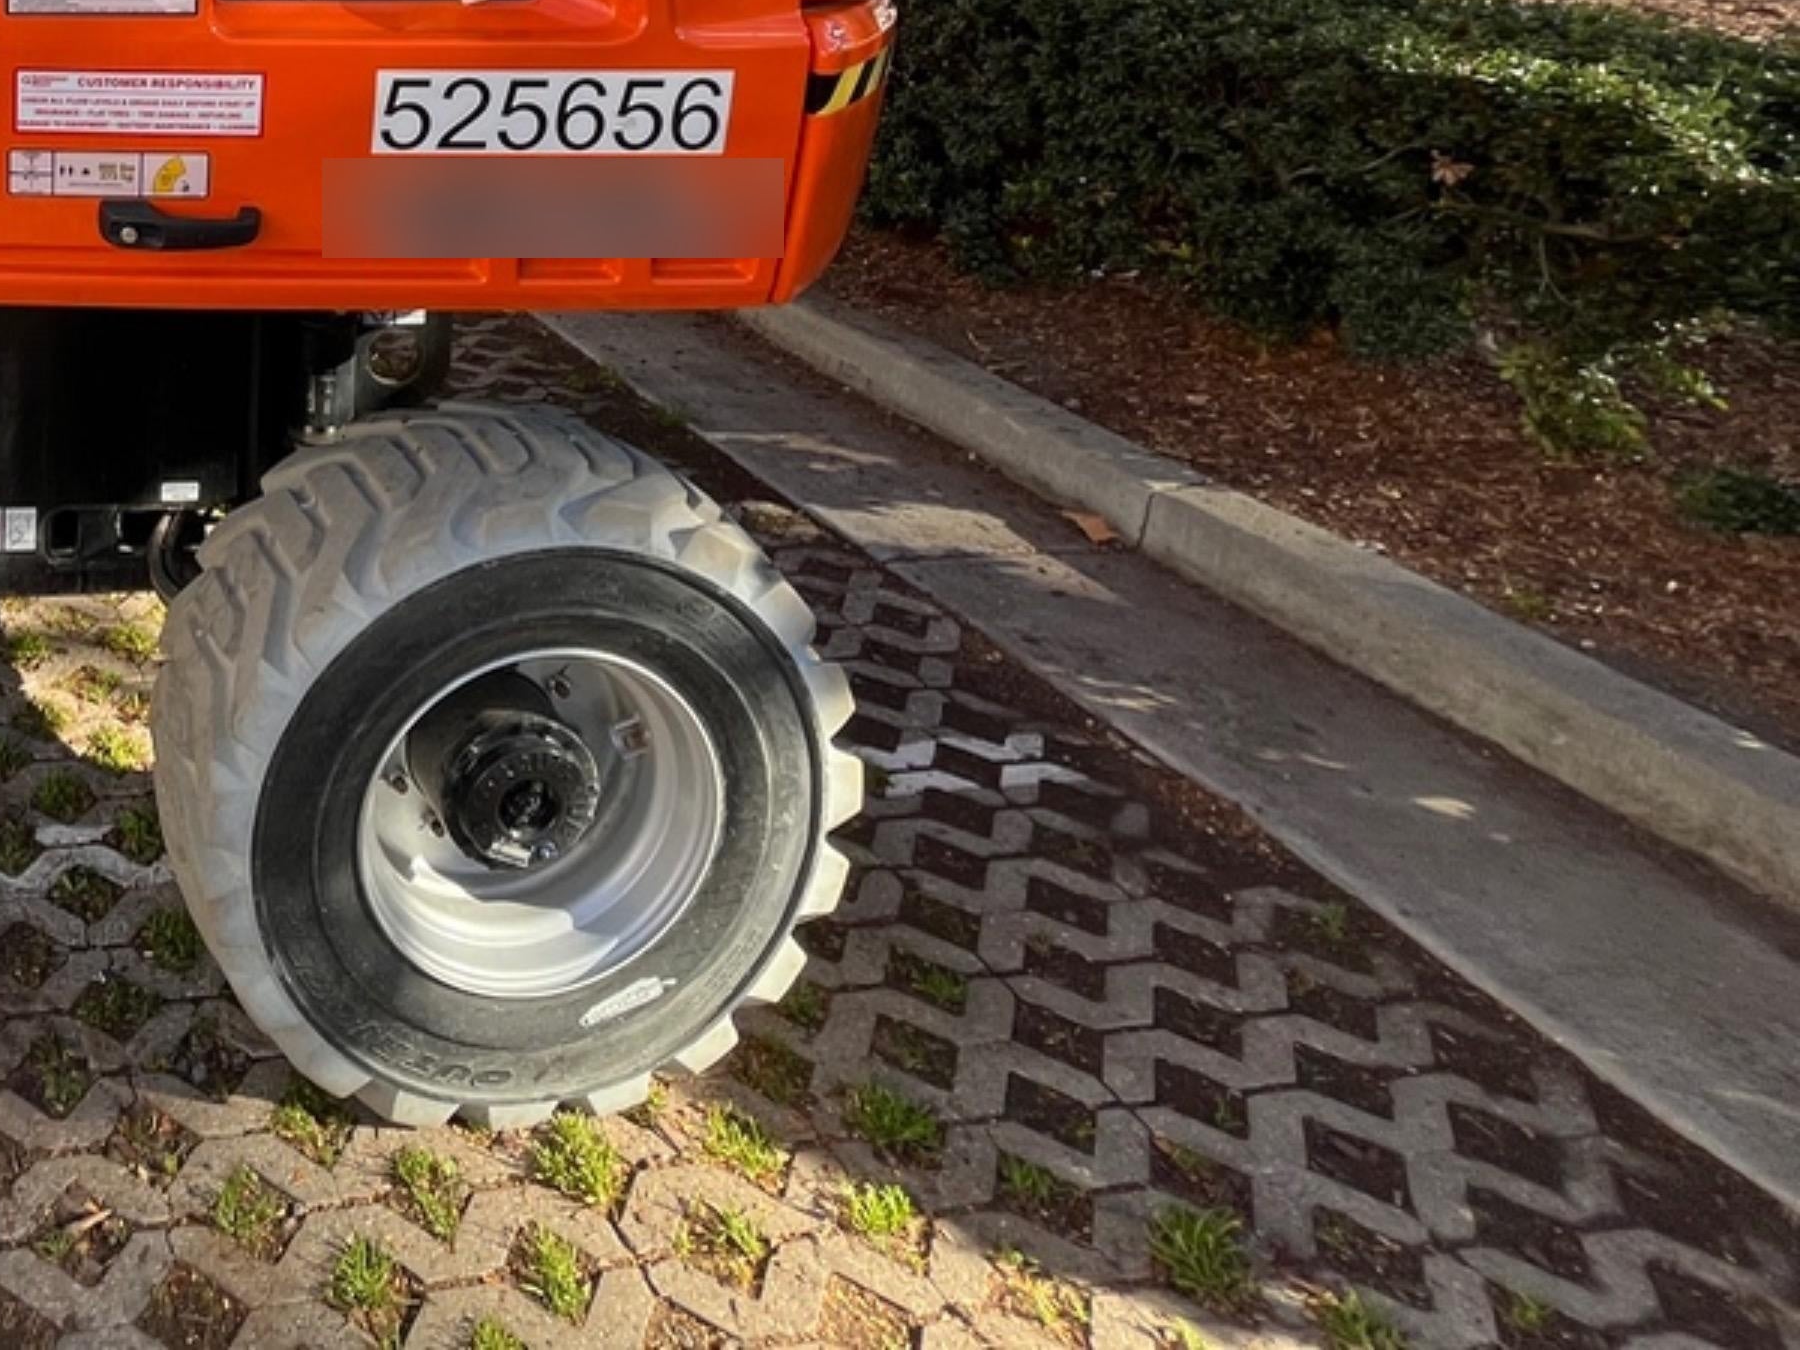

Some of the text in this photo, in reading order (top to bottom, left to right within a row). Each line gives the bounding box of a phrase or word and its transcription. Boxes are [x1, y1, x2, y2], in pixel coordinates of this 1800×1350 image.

[77, 76, 148, 88] CUSTOMER
[151, 78, 256, 90] RESPONSIBILITY
[379, 77, 722, 151] 525656
